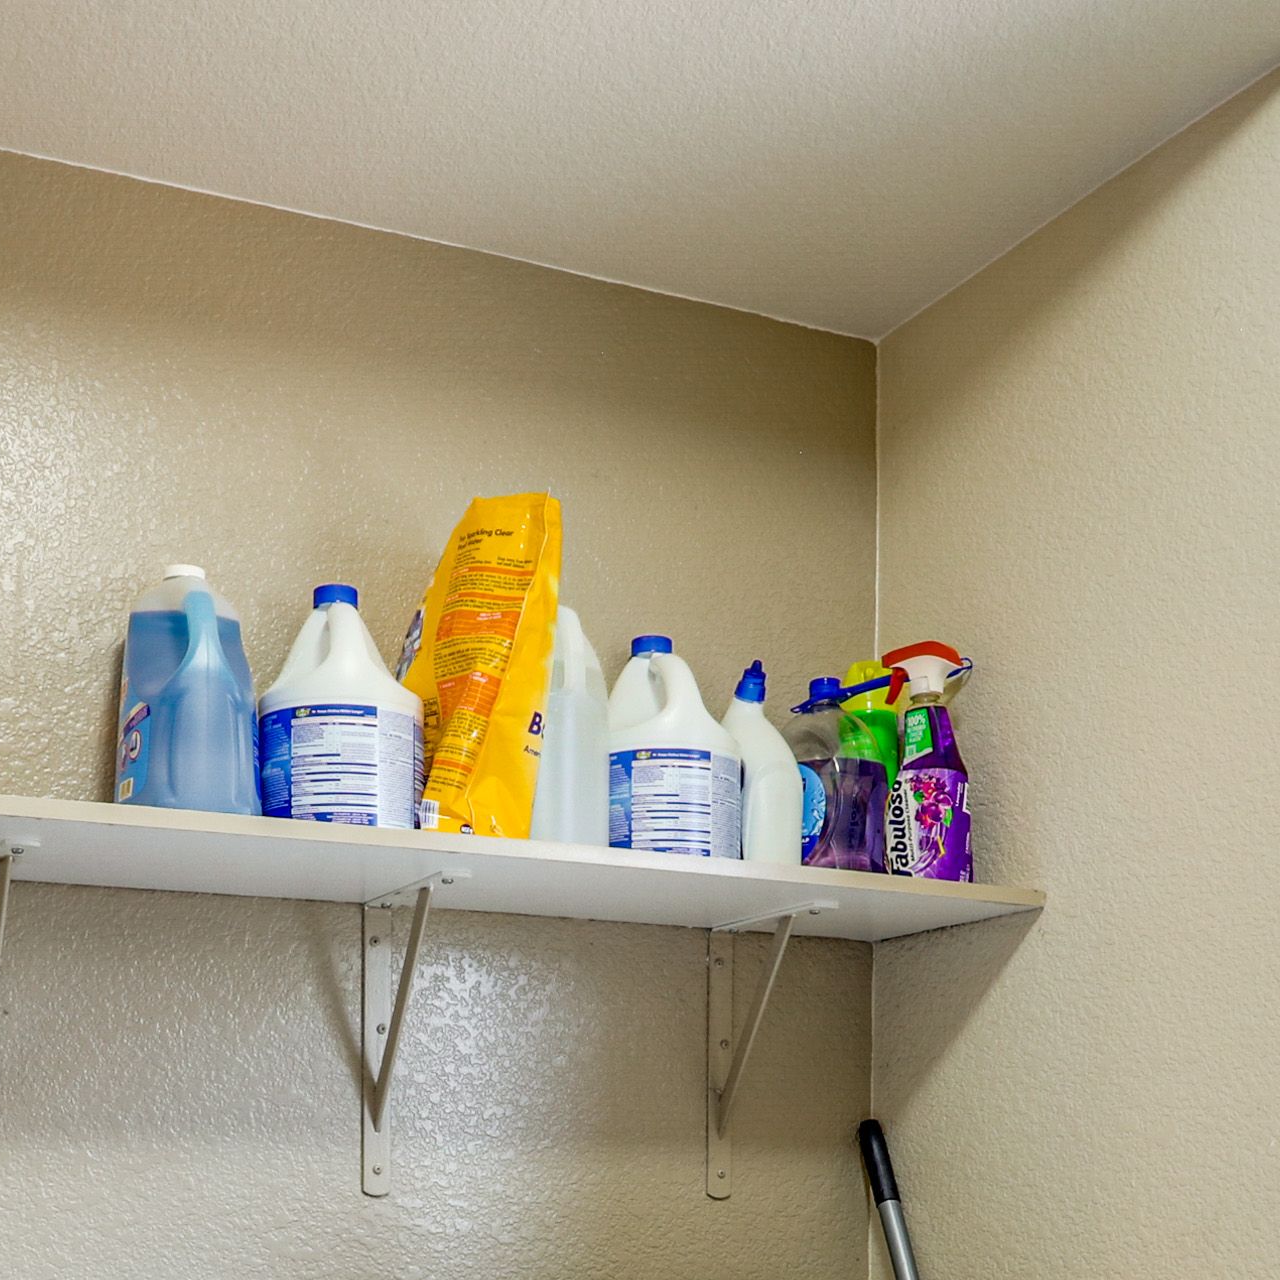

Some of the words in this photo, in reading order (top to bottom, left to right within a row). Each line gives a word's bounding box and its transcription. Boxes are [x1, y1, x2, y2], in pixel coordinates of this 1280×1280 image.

[495, 528, 514, 536] Clear
[528, 711, 546, 740] B
[888, 779, 913, 877] Fabuloso
